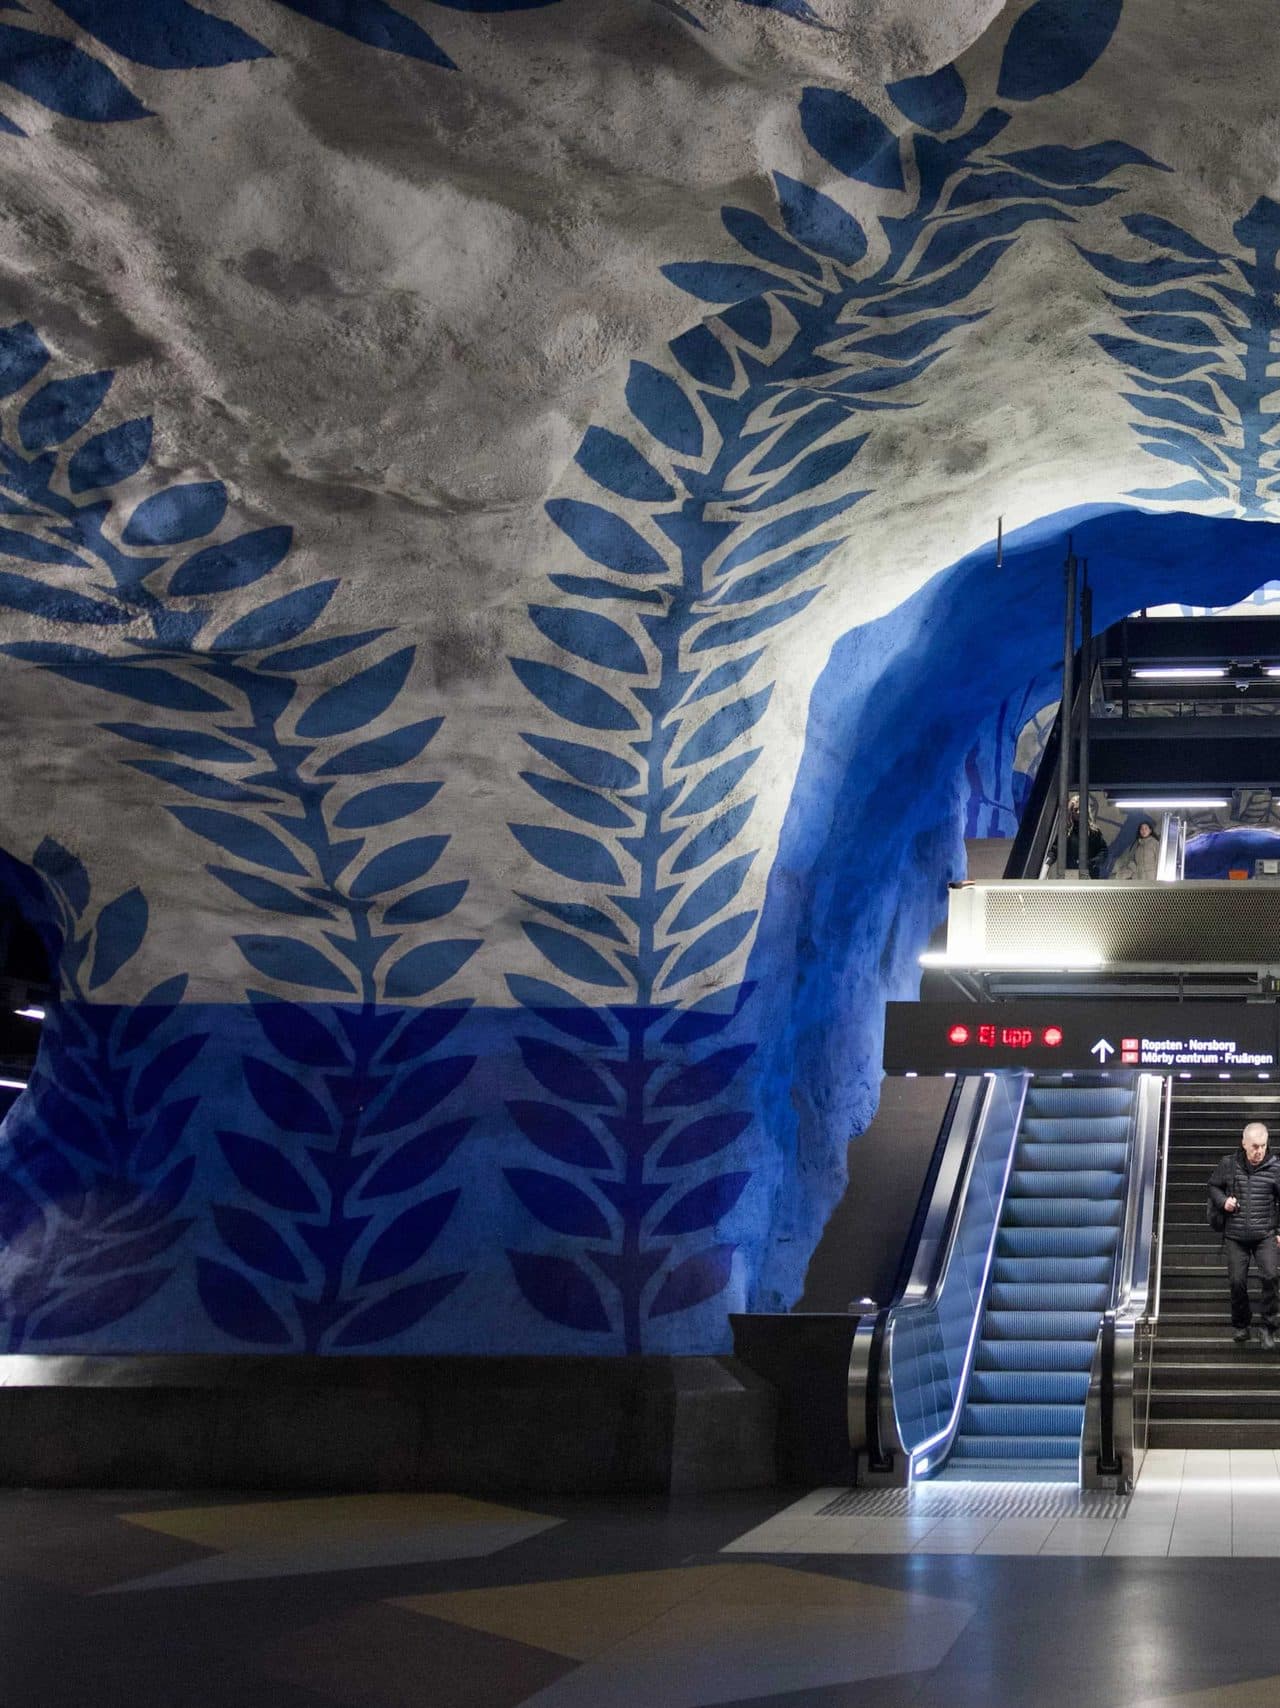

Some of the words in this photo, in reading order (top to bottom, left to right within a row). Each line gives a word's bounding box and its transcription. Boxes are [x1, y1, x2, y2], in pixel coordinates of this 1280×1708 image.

[1002, 1028, 1033, 1047] upp
[1141, 1039, 1182, 1051] Ropsten
[1189, 1039, 1236, 1052] Norsborg
[1141, 1052, 1174, 1064] Mörby
[1176, 1053, 1218, 1063] centrum
[1225, 1052, 1273, 1065] Fruängen
